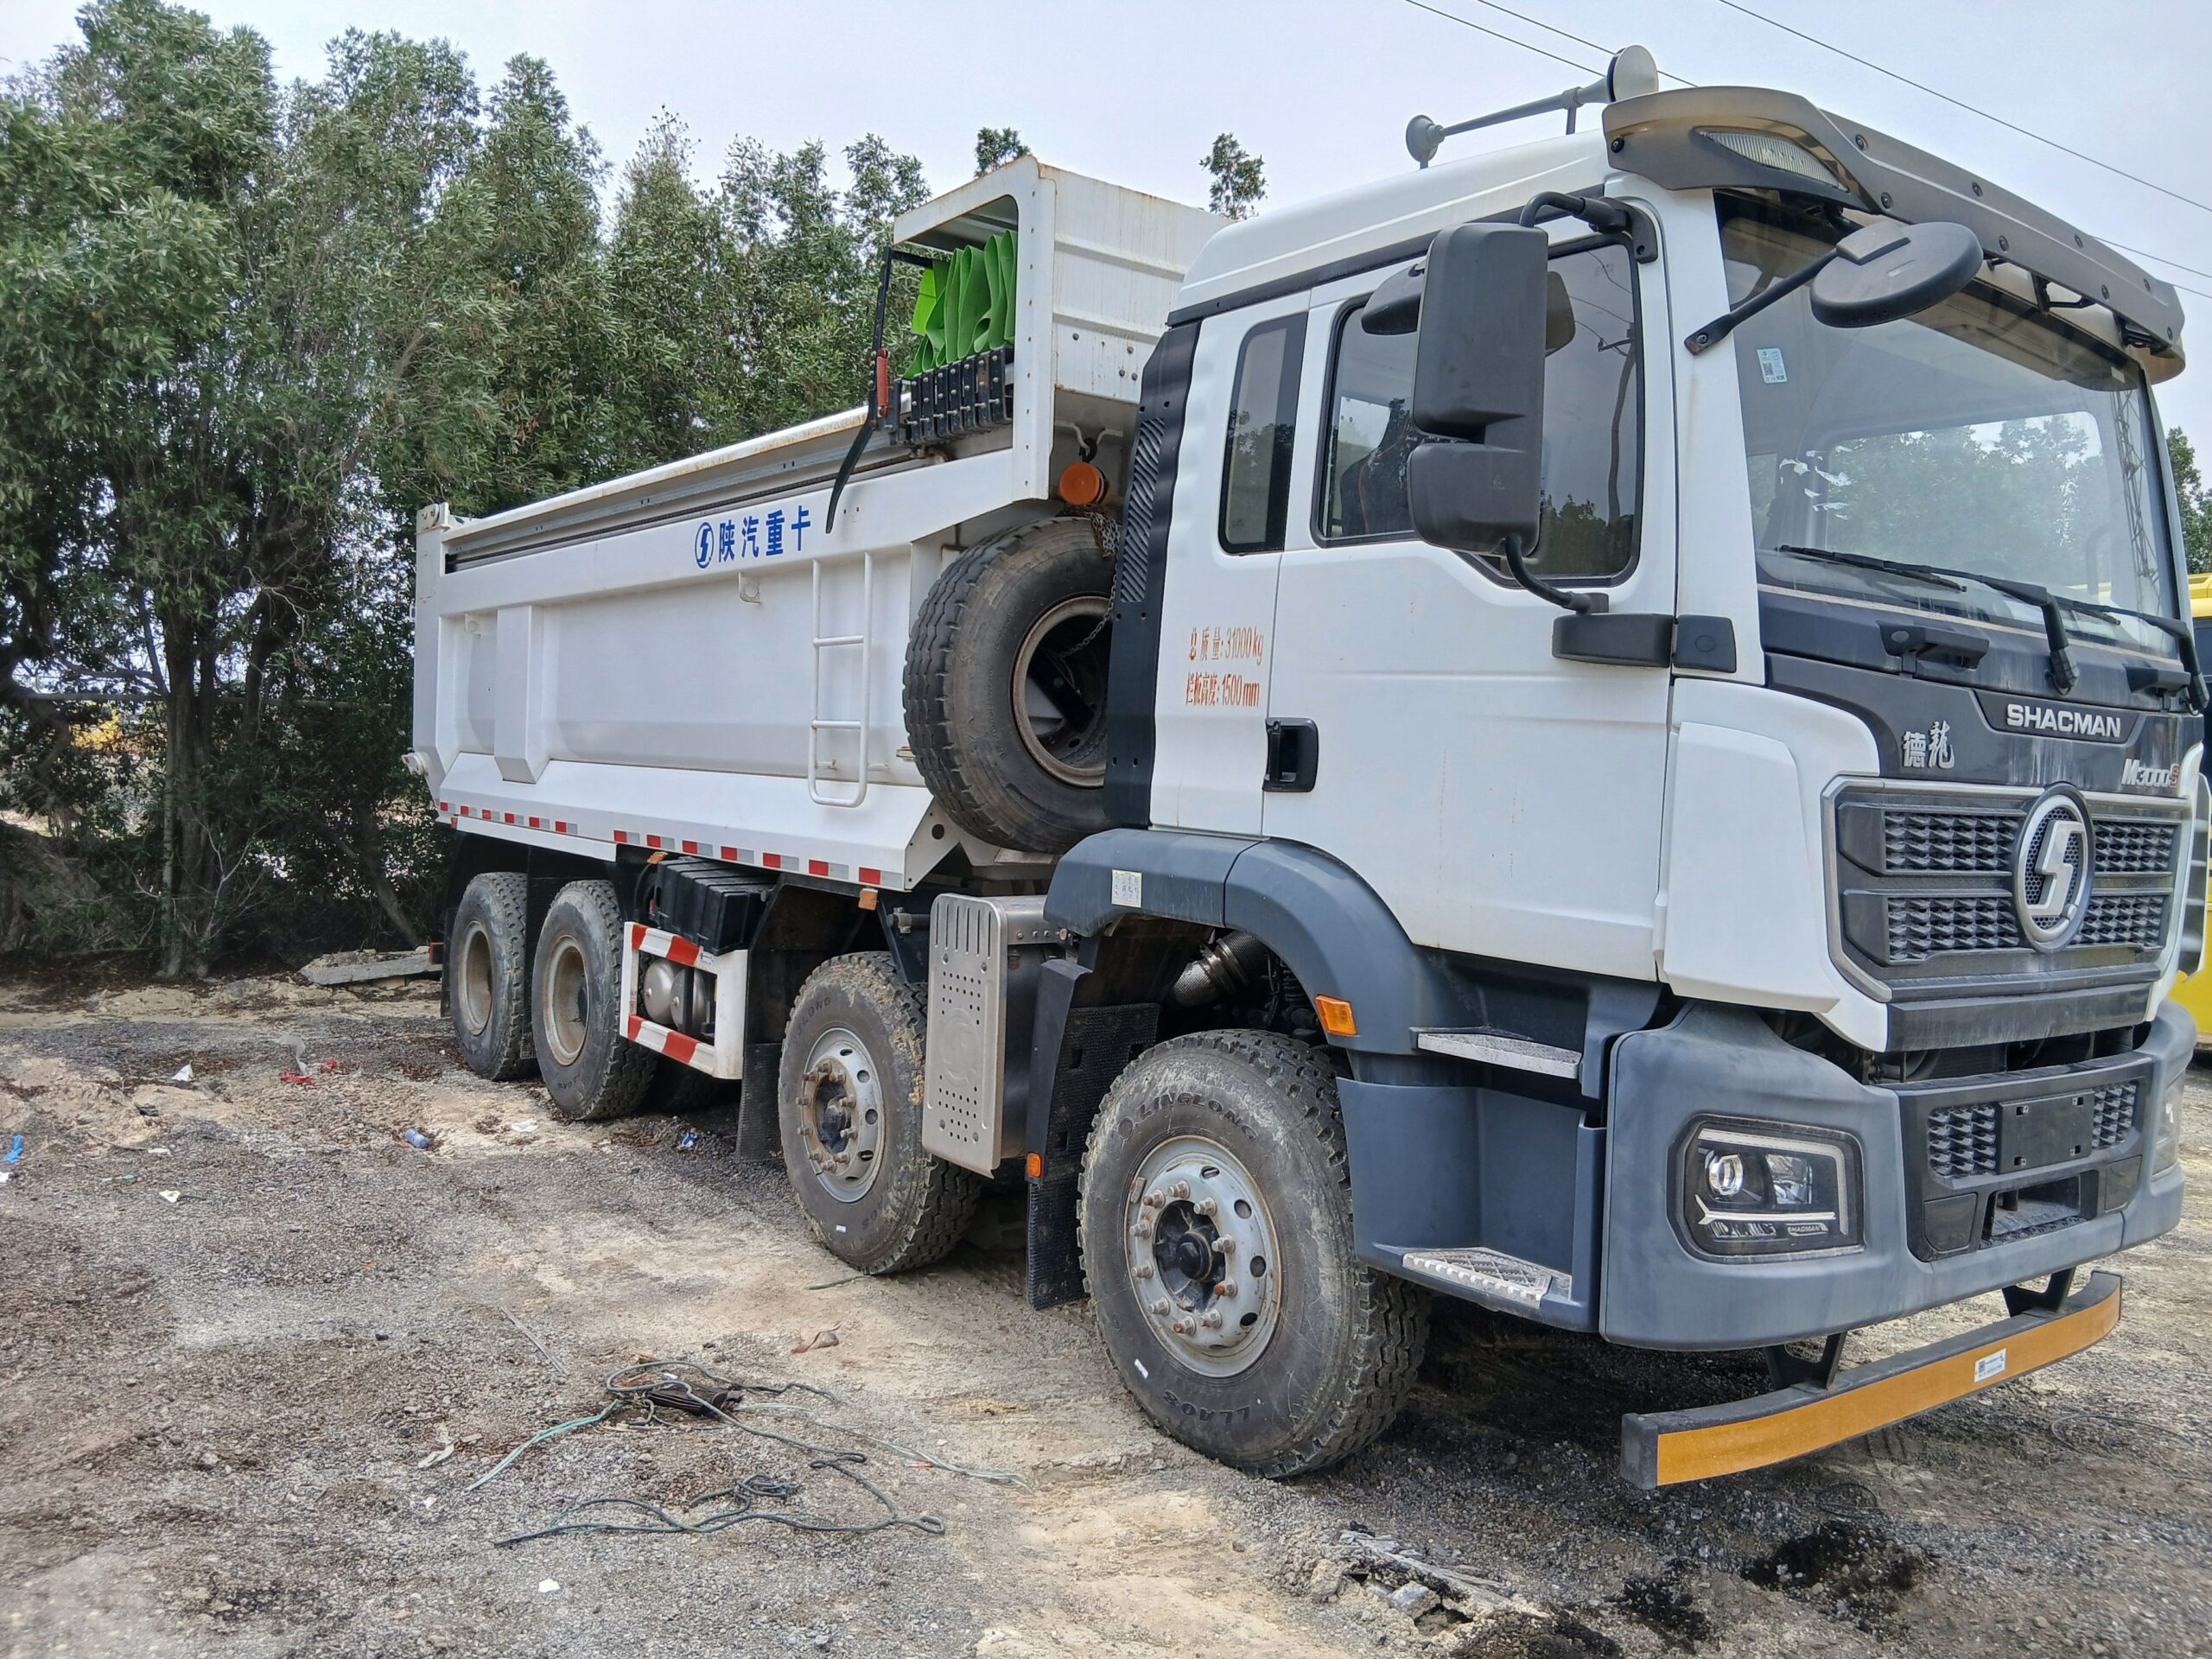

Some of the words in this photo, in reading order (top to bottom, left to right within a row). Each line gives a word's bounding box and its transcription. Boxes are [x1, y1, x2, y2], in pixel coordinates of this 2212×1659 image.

[718, 505, 811, 563] 陕汽重卡
[2006, 703, 2121, 739] SHACMAN
[2120, 758, 2181, 788] M3000S
[1137, 1092, 1258, 1141] LINGLONG
